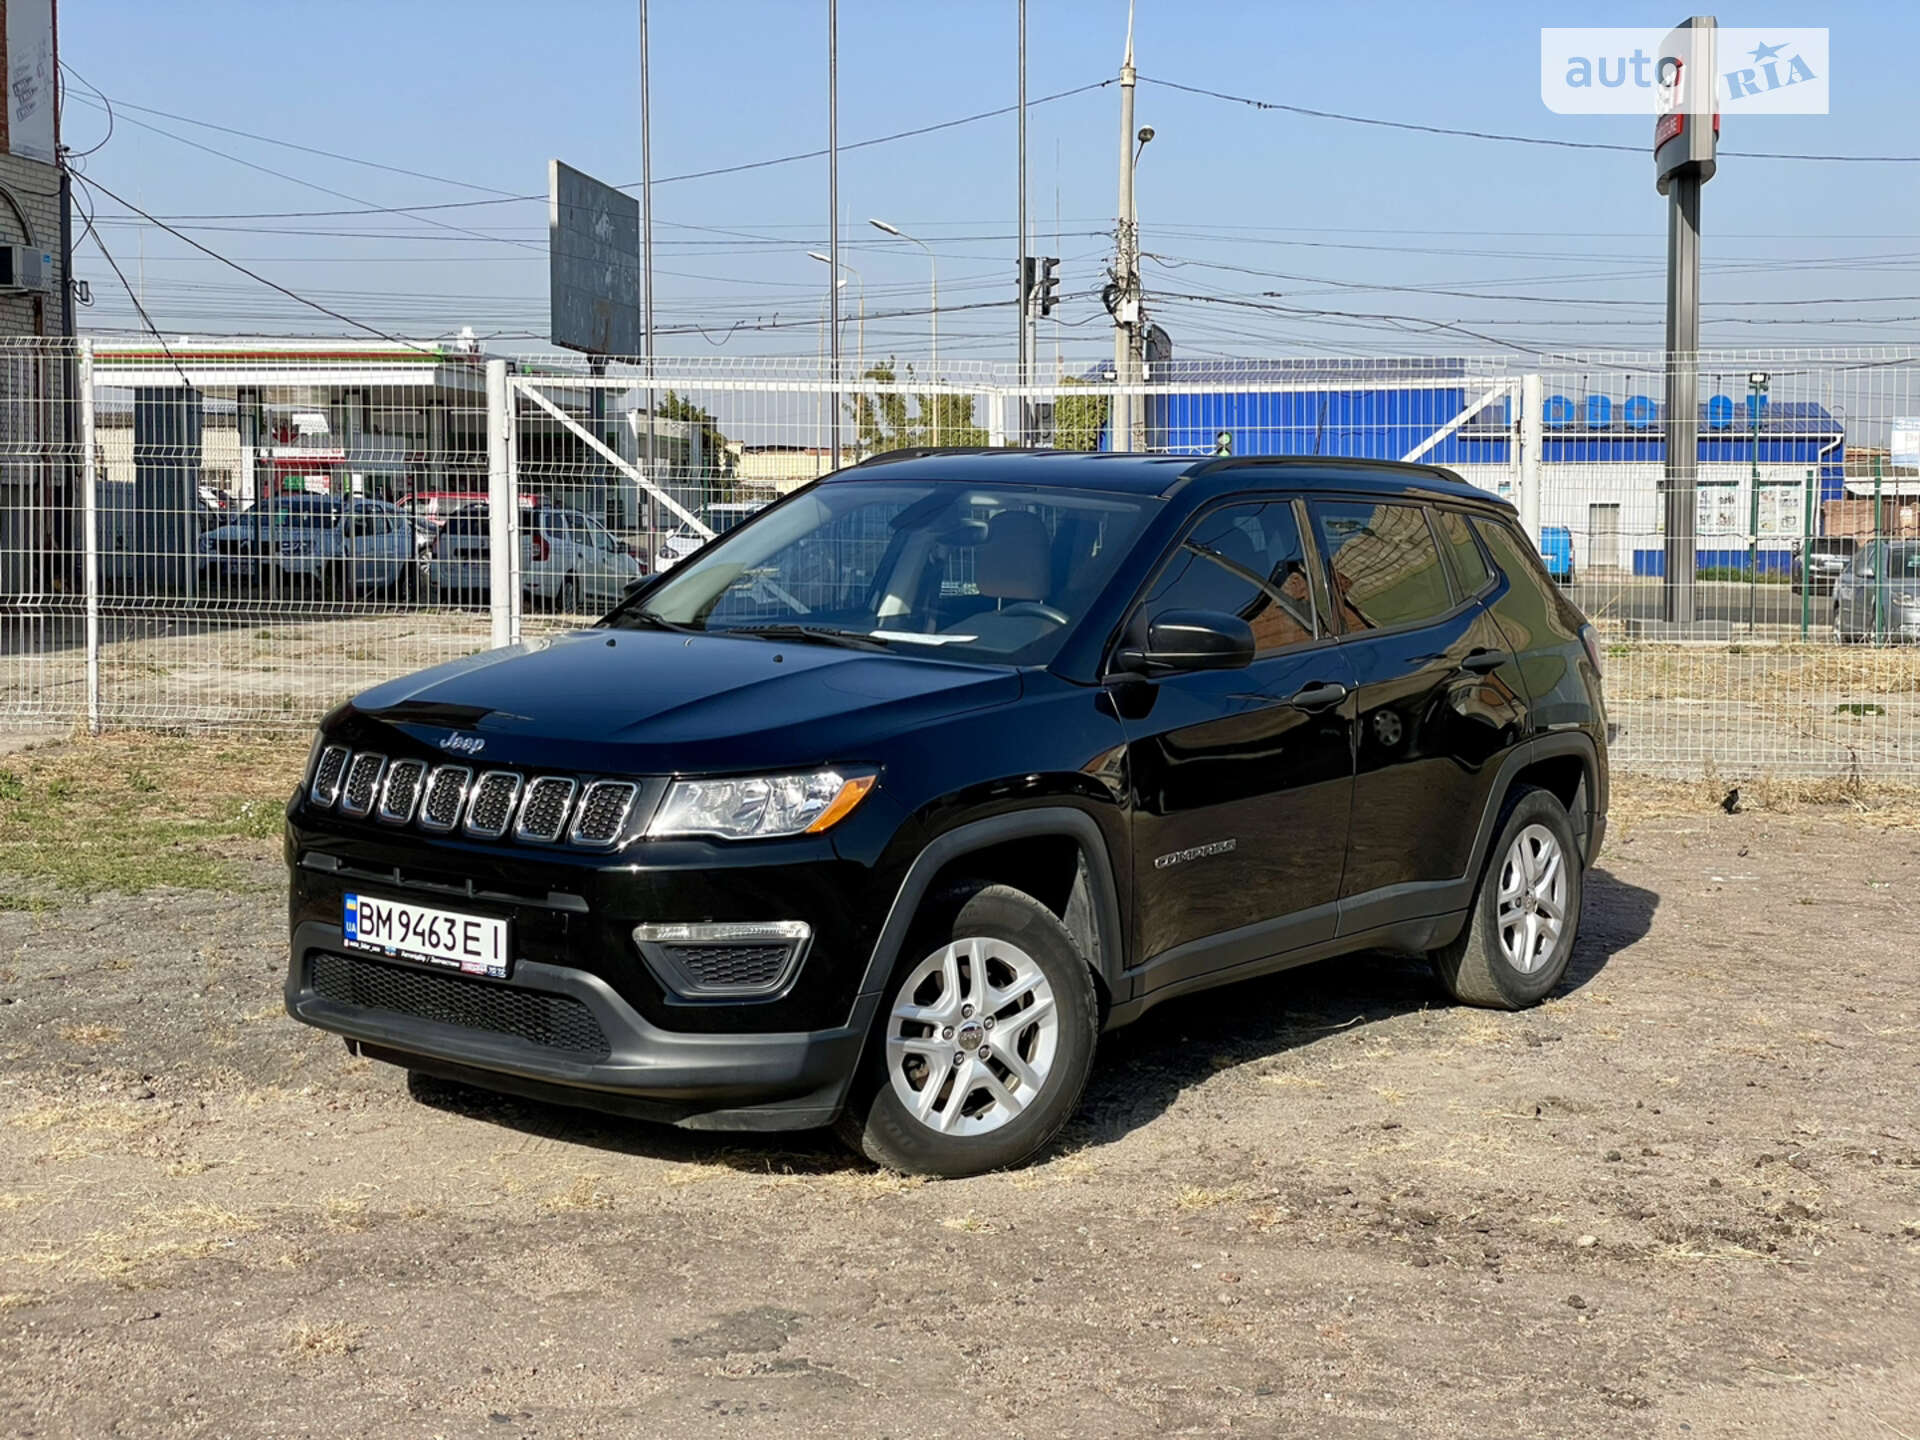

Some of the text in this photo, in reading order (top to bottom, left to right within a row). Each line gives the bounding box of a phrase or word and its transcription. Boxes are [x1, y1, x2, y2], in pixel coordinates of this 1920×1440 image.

[440, 731, 486, 754] Jeep
[1154, 838, 1237, 869] COMPASS
[346, 922, 357, 933] UA
